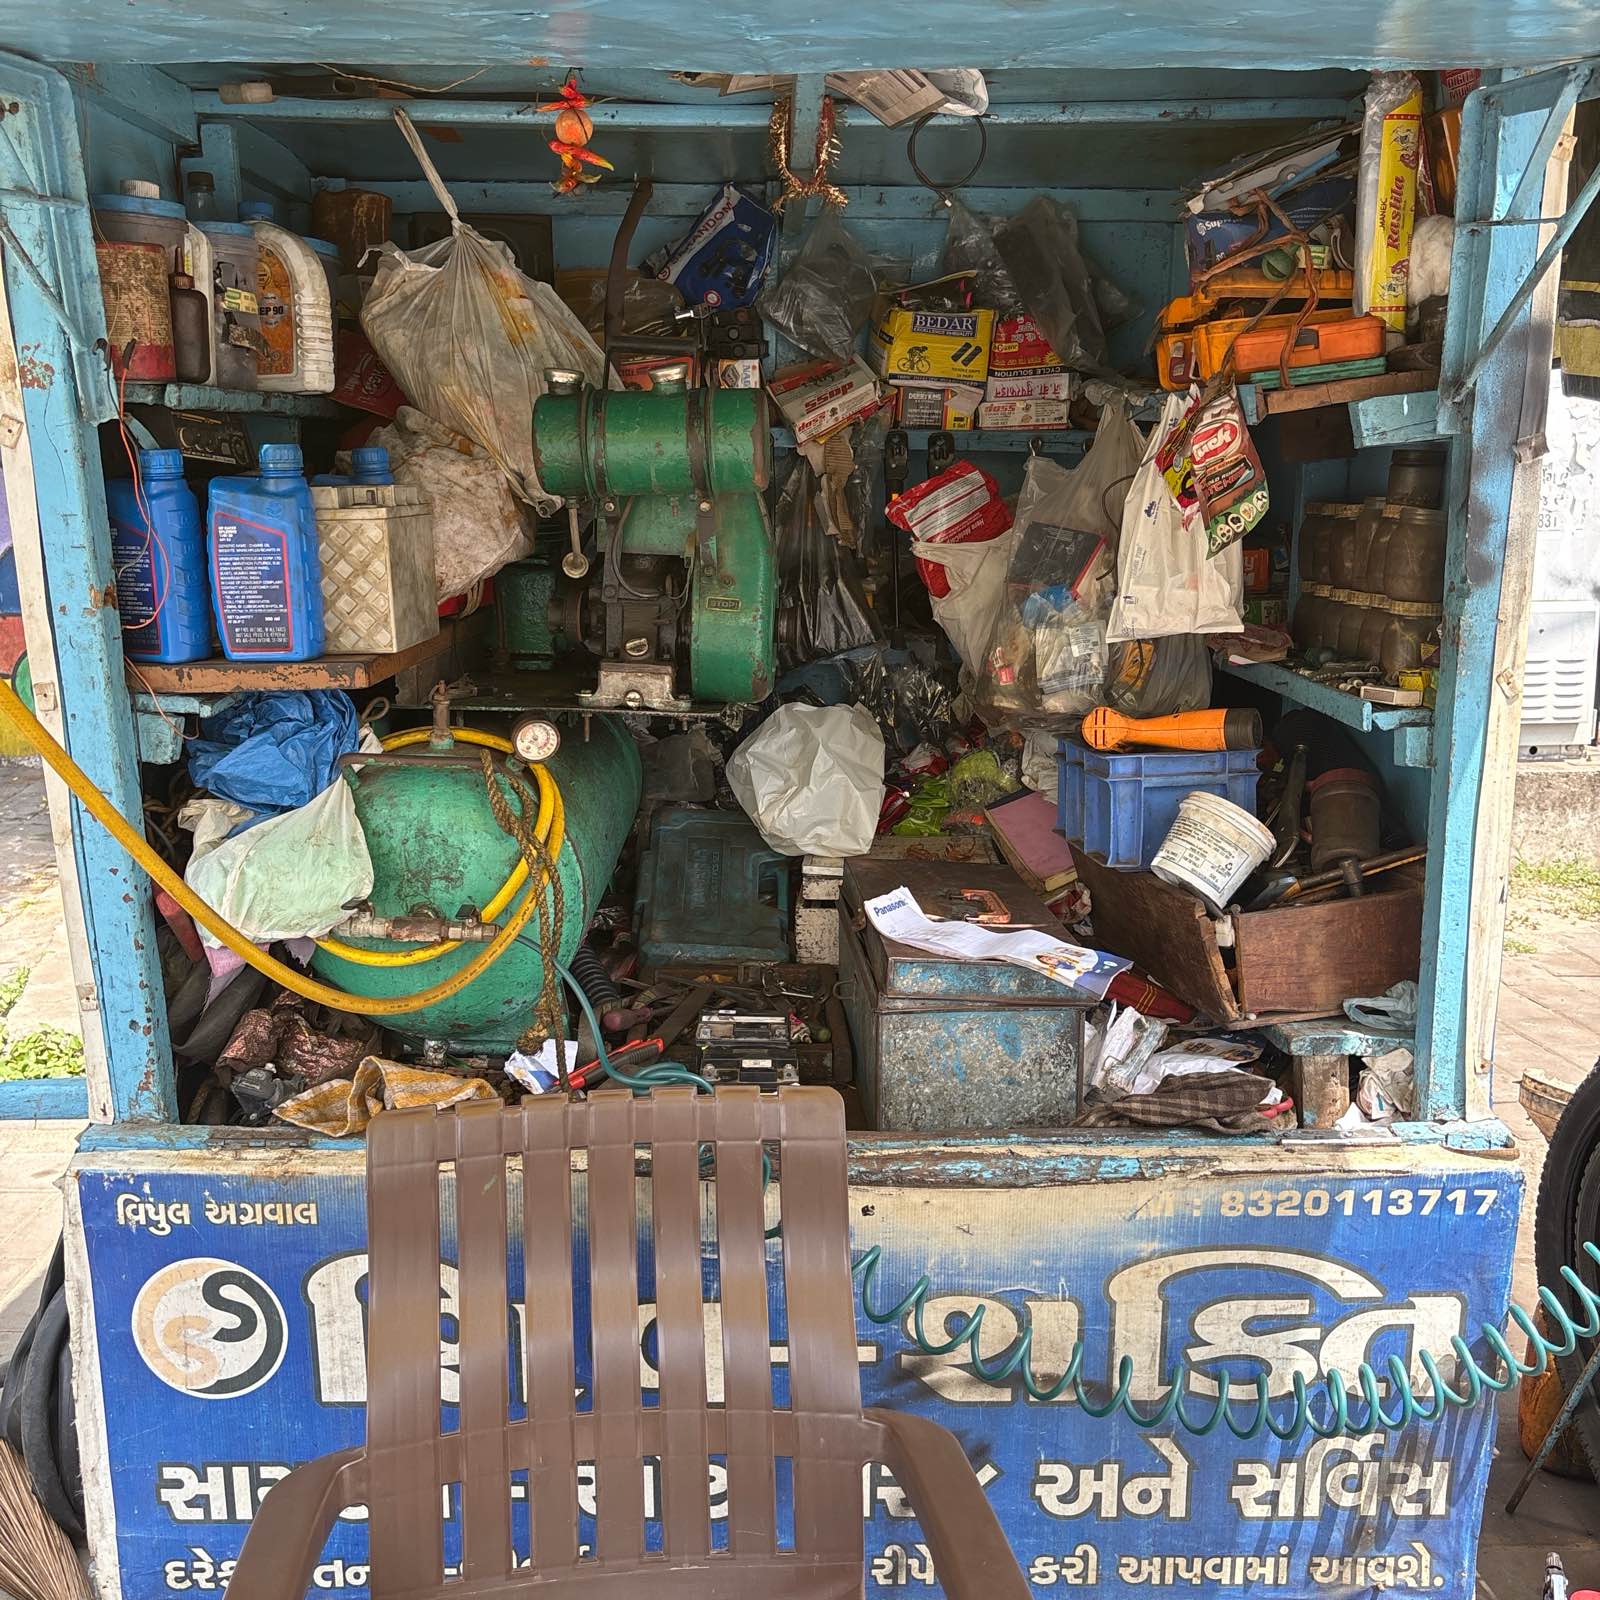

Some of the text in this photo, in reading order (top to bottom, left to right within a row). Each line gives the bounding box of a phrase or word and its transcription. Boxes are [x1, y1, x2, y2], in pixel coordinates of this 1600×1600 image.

[273, 306, 284, 314] 90
[916, 315, 973, 330] BEDAR
[1036, 367, 1060, 375] CYCLE
[116, 1194, 318, 1236] વિપુલ અગ્રવાલ
[1220, 1189, 1498, 1217] 8320113717
[1034, 1437, 1193, 1517] અને
[1029, 1544, 1098, 1585] કરી
[1118, 1545, 1289, 1585] આપવામાં
